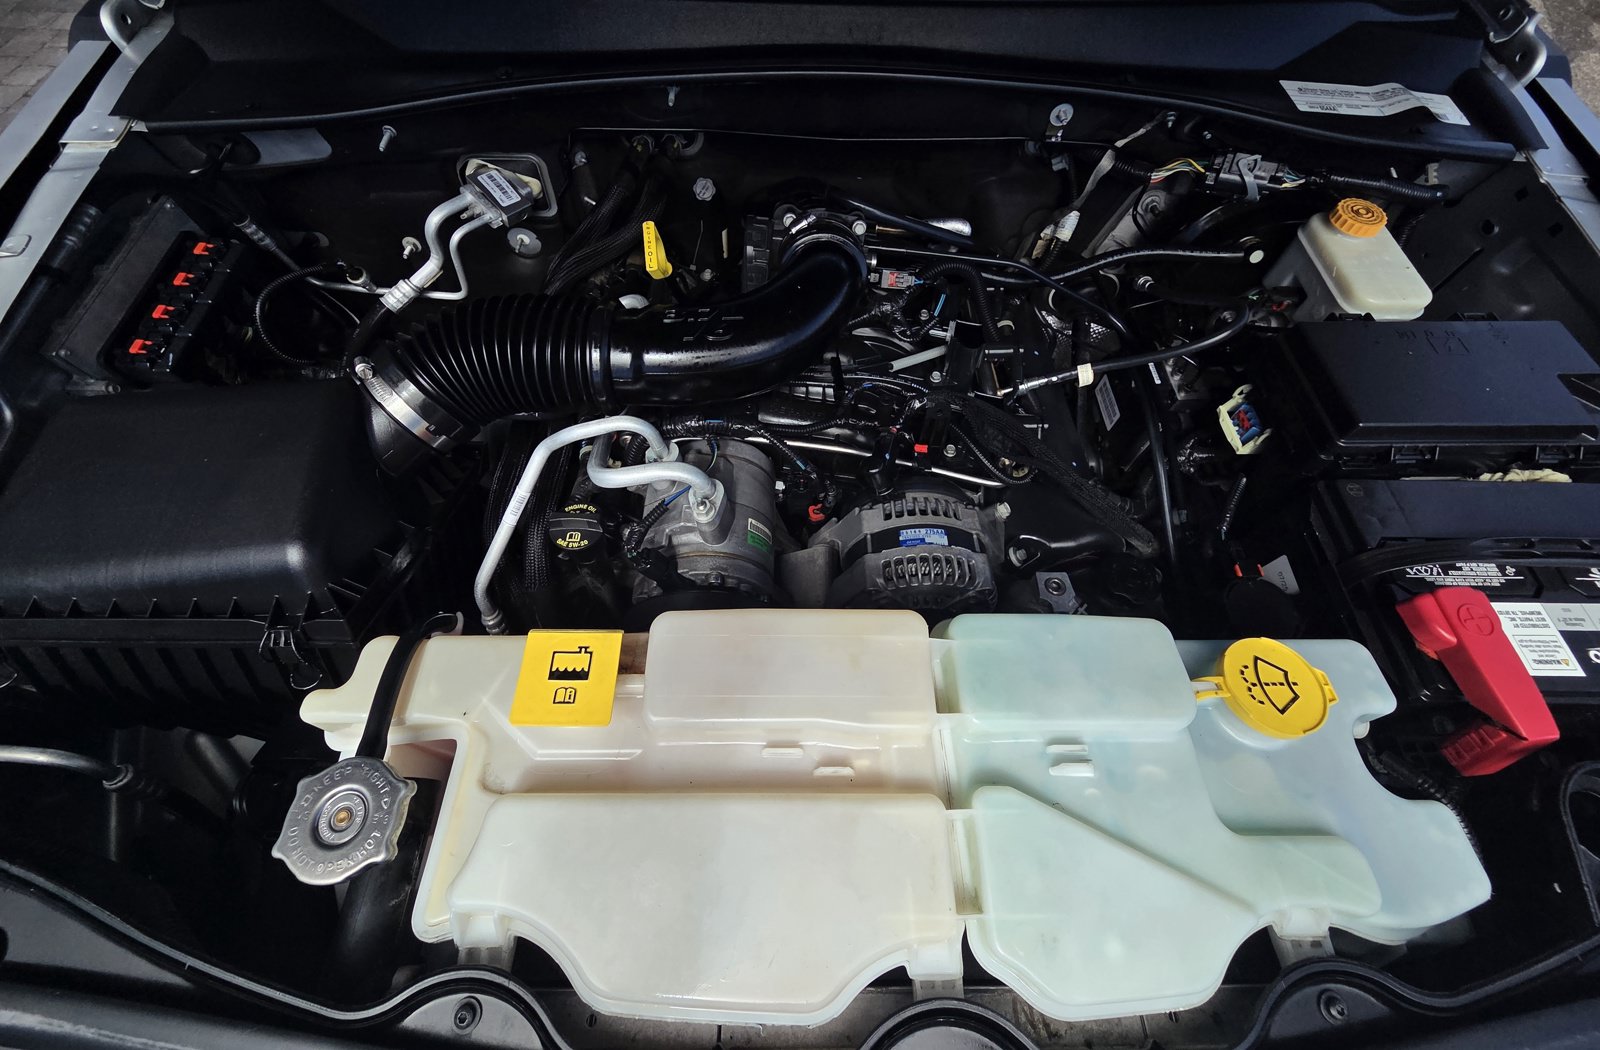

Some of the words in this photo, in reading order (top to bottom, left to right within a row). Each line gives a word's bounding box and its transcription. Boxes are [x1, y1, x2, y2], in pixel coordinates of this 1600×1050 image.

[564, 504, 588, 512] ENGINE
[587, 505, 597, 514] OIL
[568, 539, 589, 548] 5W-20
